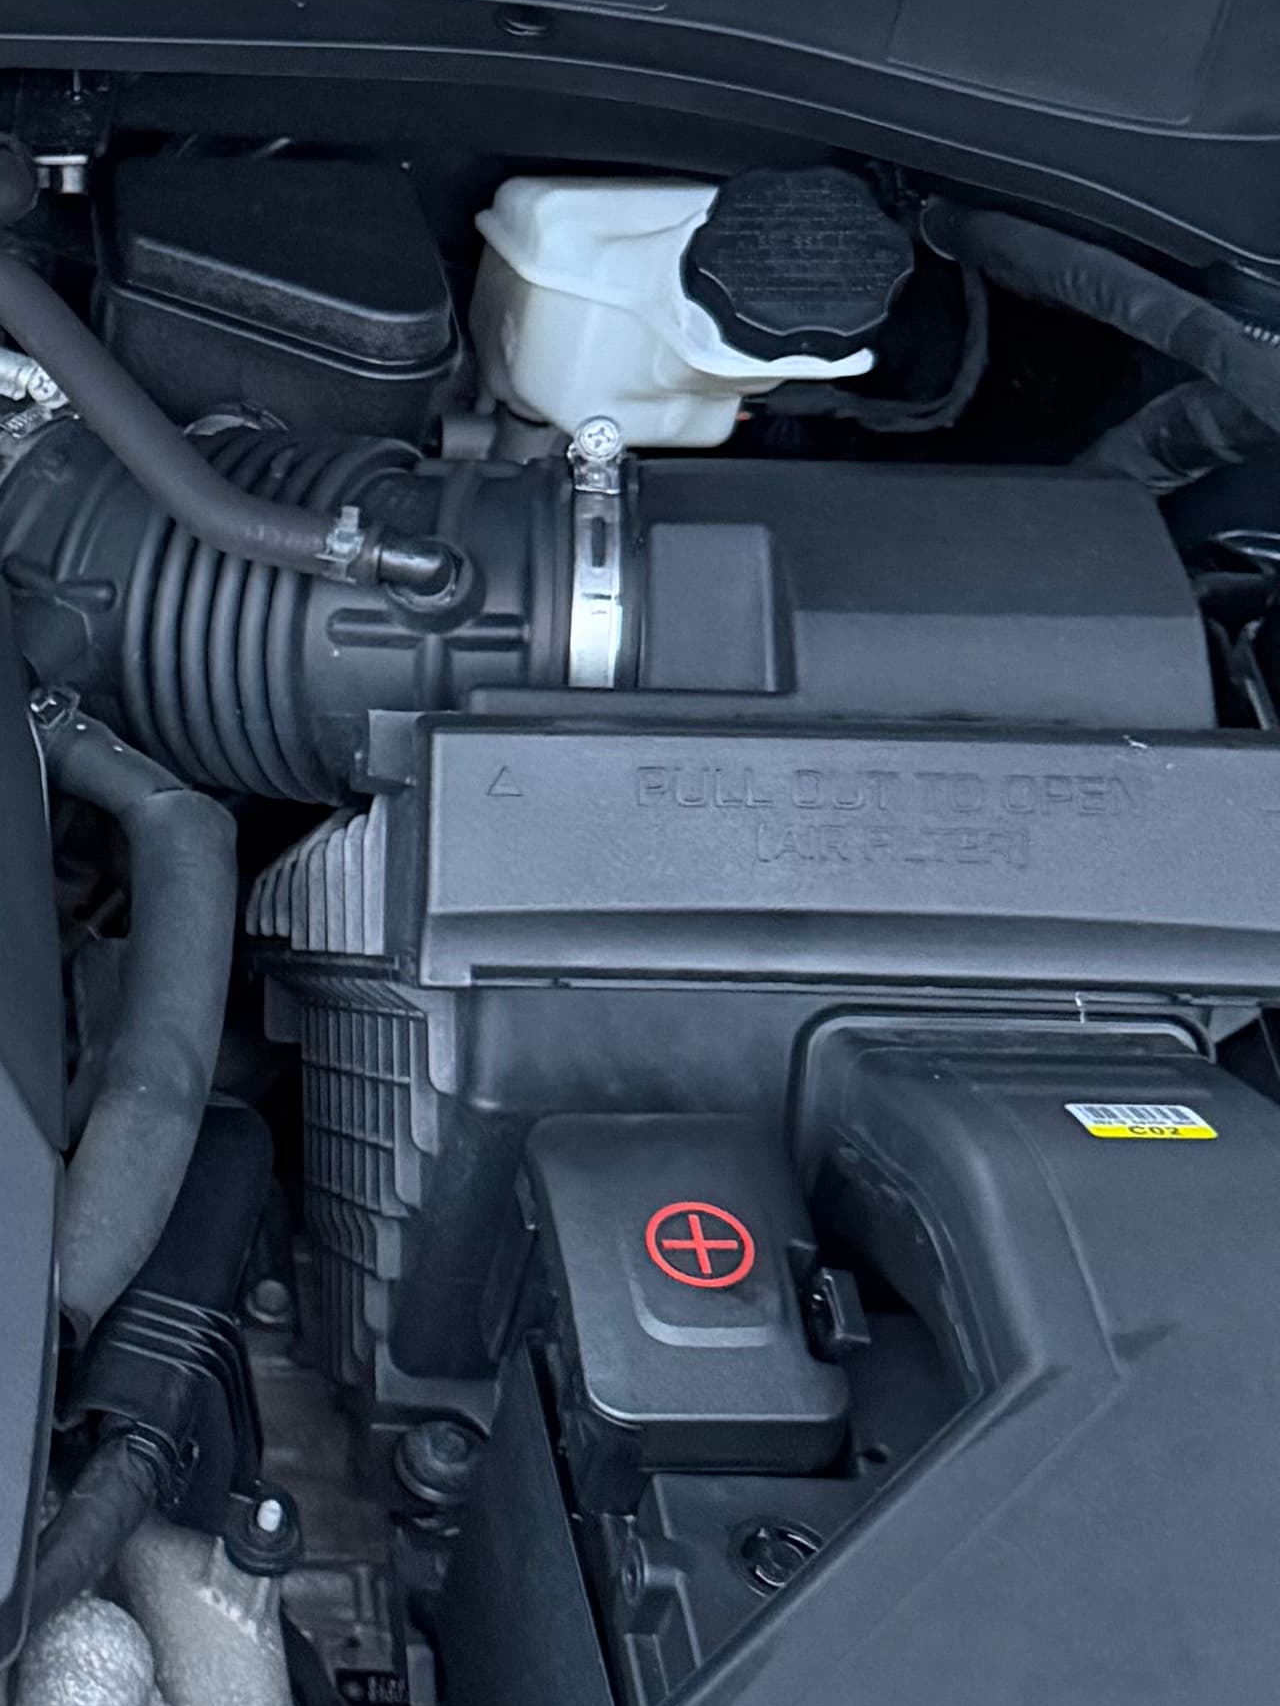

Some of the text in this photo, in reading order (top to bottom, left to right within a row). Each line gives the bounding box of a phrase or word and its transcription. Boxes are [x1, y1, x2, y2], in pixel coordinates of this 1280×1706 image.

[637, 765, 1143, 819] PULL OUT TO OPEN
